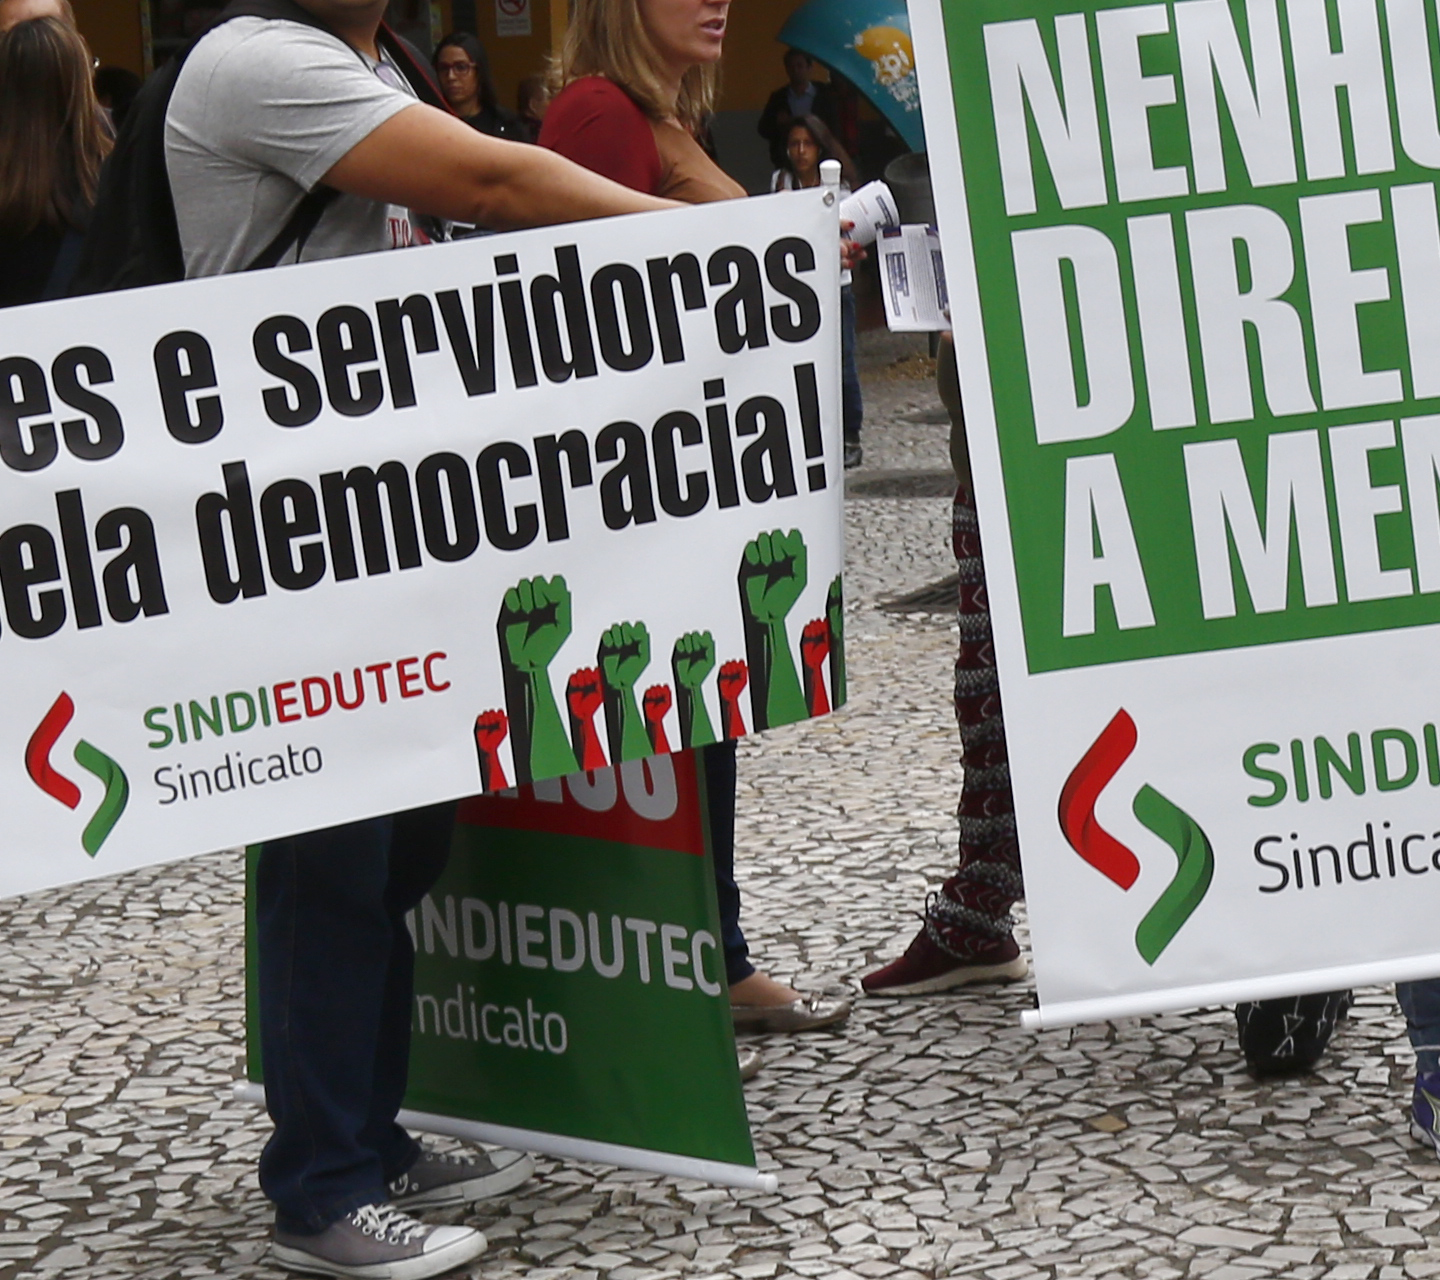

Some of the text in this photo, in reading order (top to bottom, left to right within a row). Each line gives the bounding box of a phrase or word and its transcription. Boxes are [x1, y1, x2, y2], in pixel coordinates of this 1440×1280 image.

[163, 344, 225, 445] e
[260, 236, 824, 428] servidoras
[199, 365, 831, 602] democracia!
[1061, 453, 1156, 638] A
[142, 650, 453, 751] SINDIEDUTEC
[153, 742, 323, 807] Sindicato
